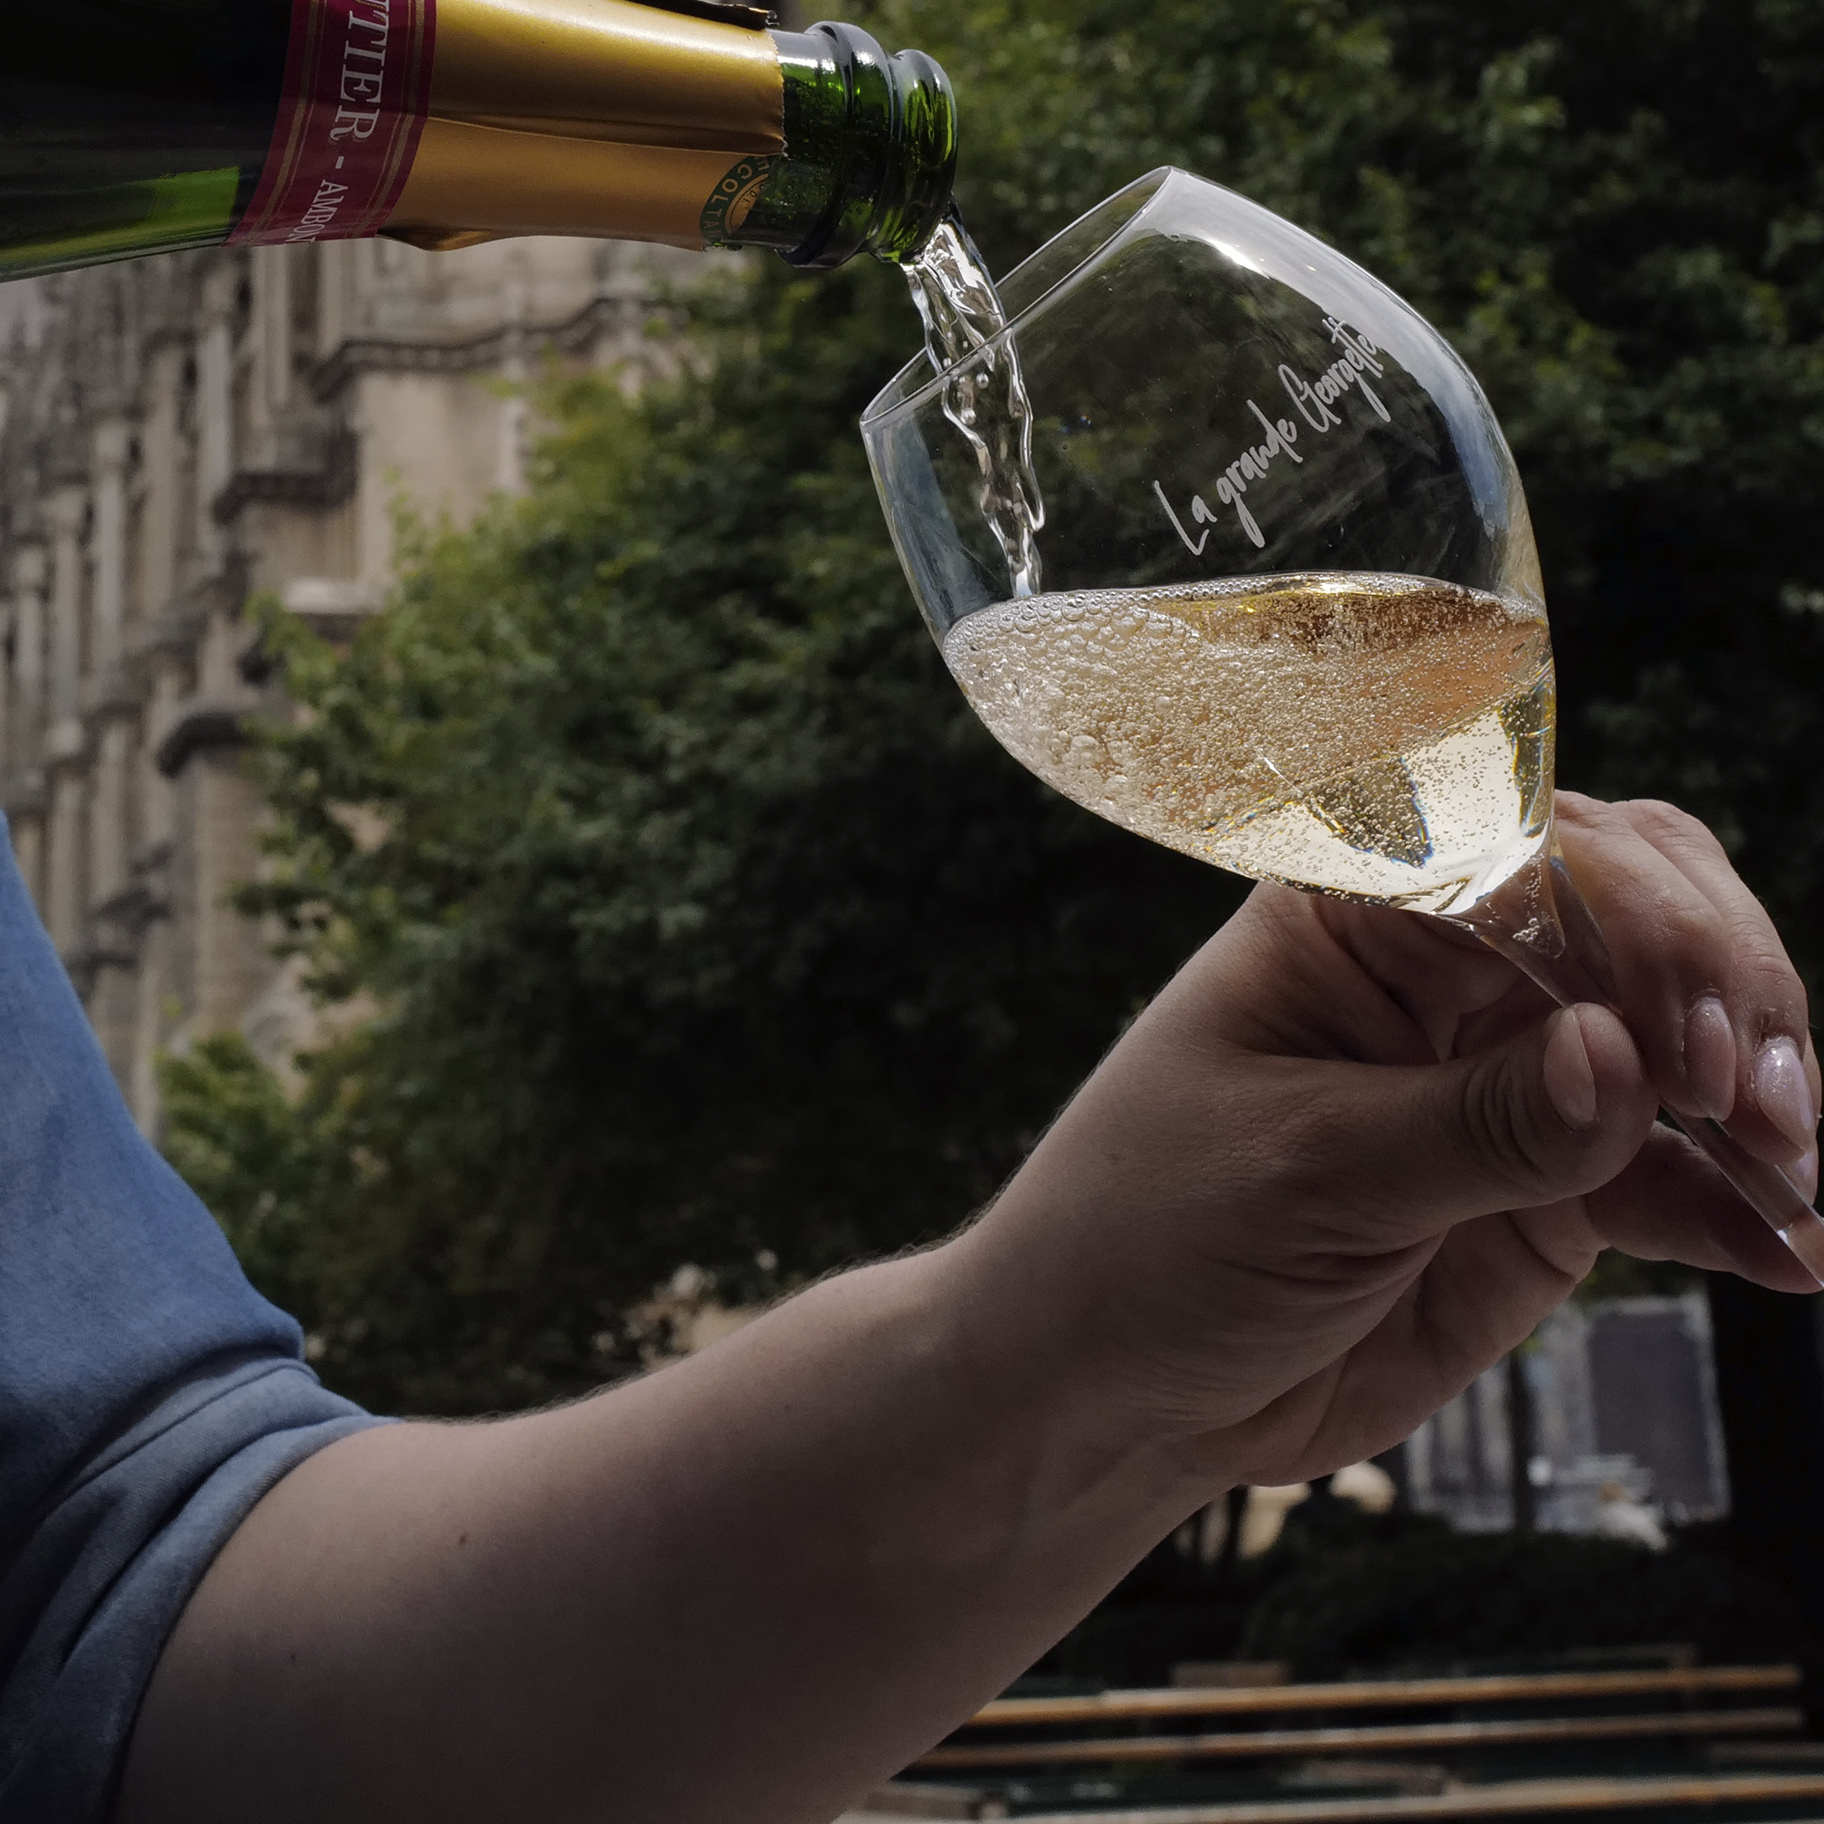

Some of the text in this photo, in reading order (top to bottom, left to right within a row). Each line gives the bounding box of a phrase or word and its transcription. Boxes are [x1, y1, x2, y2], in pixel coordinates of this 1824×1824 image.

[284, 179, 349, 243] AMBON
[1154, 317, 1391, 556] La grande Georgette
